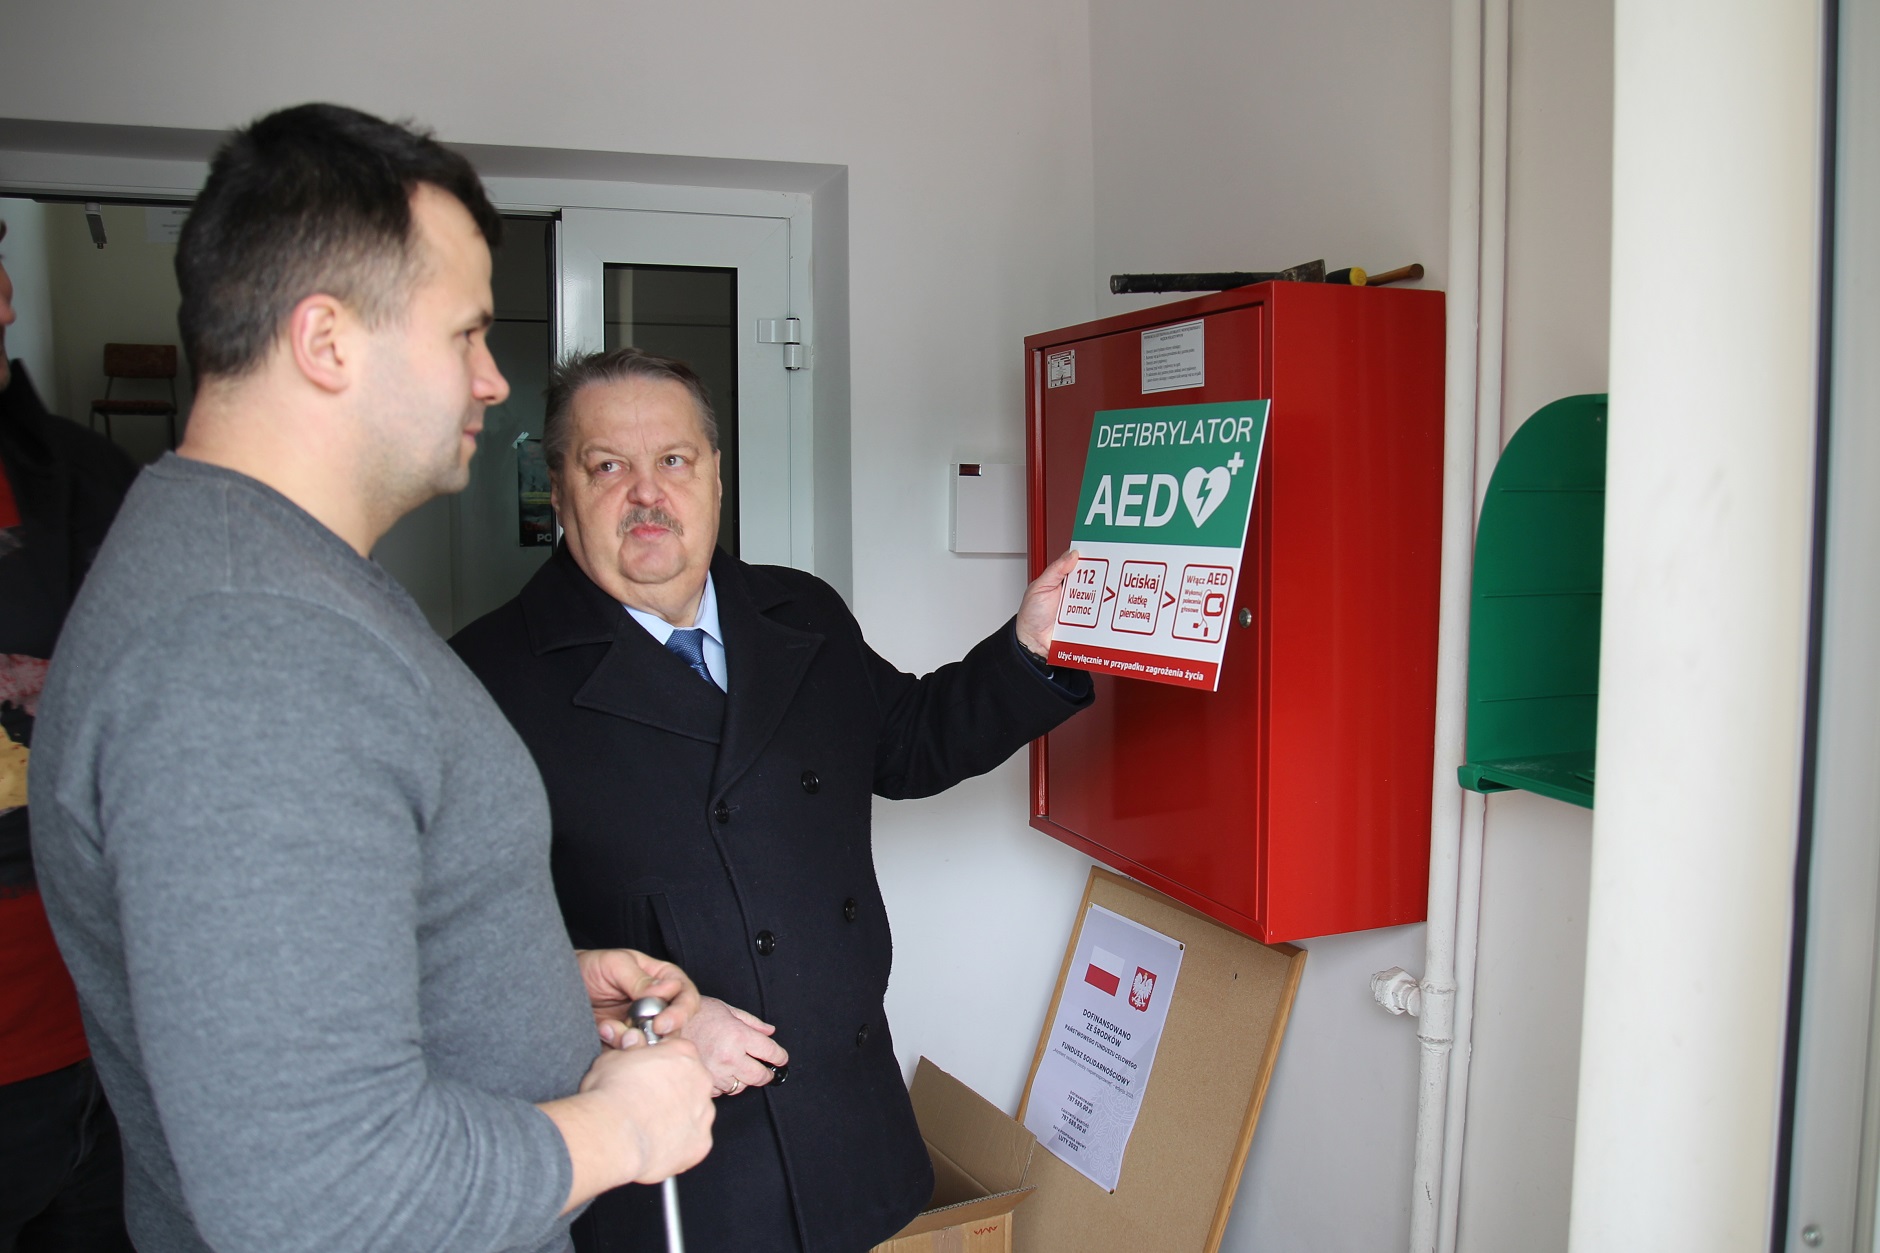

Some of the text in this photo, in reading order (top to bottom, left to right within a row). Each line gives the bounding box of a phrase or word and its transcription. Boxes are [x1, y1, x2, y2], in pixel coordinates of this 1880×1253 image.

[1097, 417, 1253, 448] DEFIBRYLATOR
[1084, 473, 1179, 527] AED
[1076, 569, 1096, 585] 112
[1123, 573, 1161, 594] Uciskaj
[1187, 572, 1228, 586] Włącz AED
[1069, 588, 1096, 604] Wezwij
[1127, 594, 1148, 608] klatkę
[1066, 605, 1092, 616] pomoc
[1119, 608, 1151, 623] piersiową
[1057, 651, 1072, 661] Użyć
[1072, 653, 1103, 666] wyłącznie
[1110, 660, 1145, 673] przypadku
[1145, 664, 1184, 679] zagrożenia
[1184, 668, 1204, 681] życia
[1082, 1008, 1132, 1041] DOFINANSOWANO
[1086, 1022, 1122, 1048] ZE ŚRODKÓW
[1061, 1041, 1084, 1059] FUNDUSZ
[1083, 1054, 1131, 1087] SOLIDARNOŚCIOWY
